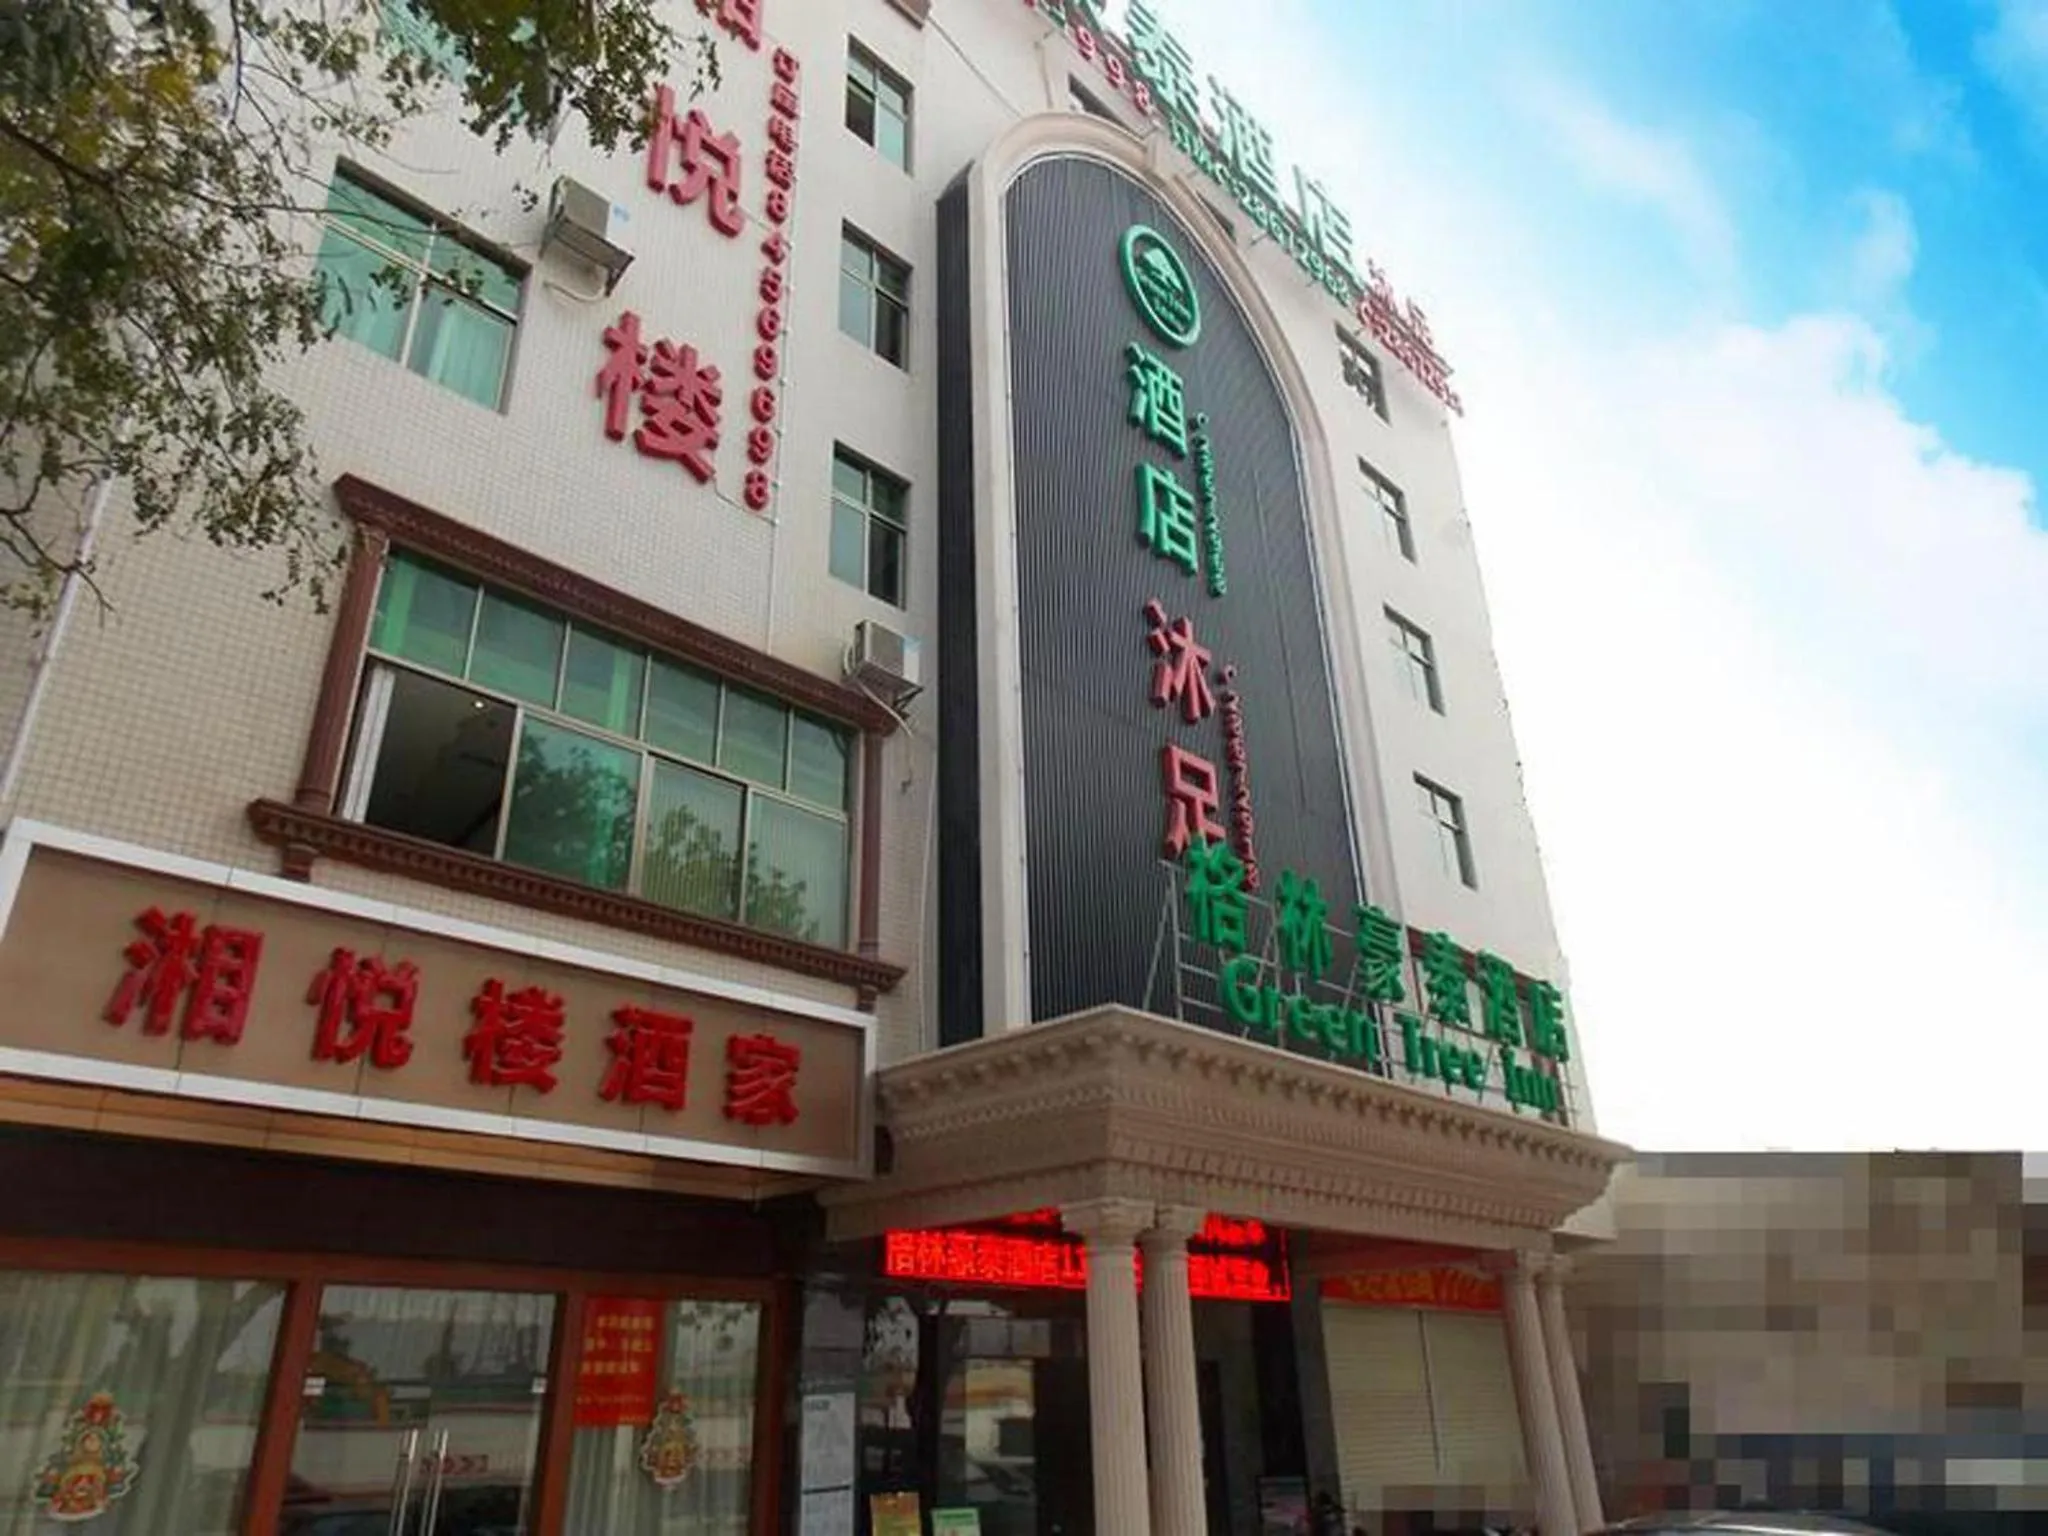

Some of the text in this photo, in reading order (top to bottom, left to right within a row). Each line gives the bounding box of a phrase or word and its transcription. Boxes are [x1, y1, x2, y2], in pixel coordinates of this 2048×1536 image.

[1127, 342, 1198, 574] 酒店
[1143, 597, 1227, 861] 沐足
[103, 905, 802, 1127] 湘悦楼酒家
[1186, 833, 1569, 1062] 格林豪泰酒店
[1222, 953, 1378, 1064] Green
[1393, 1011, 1486, 1092] Tree
